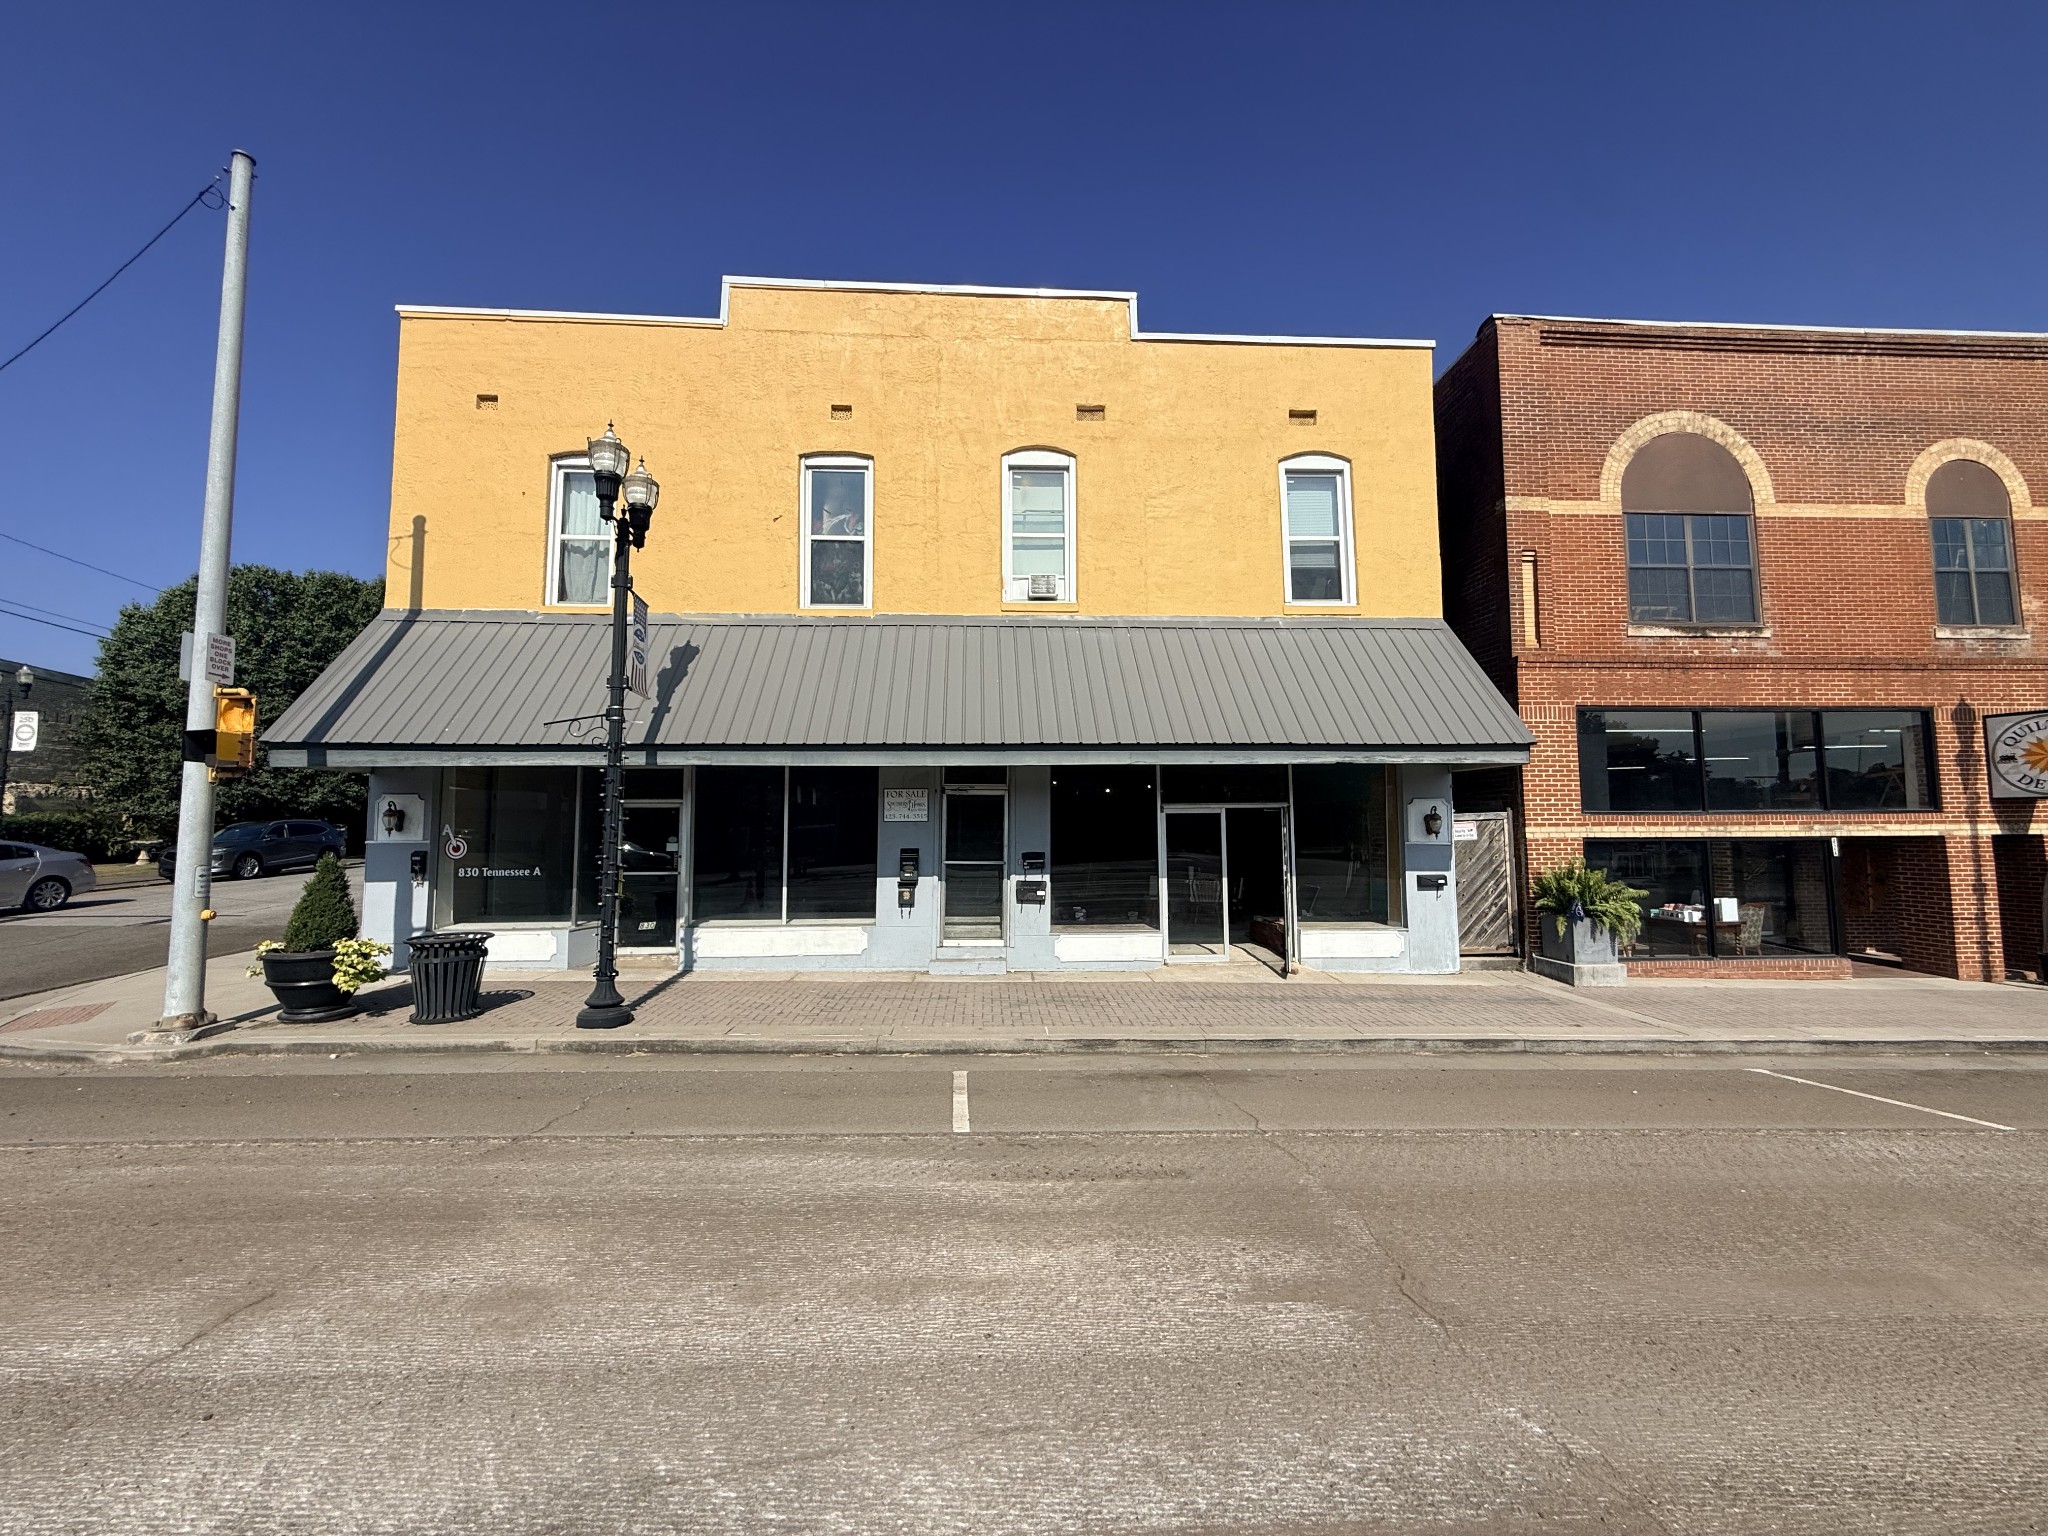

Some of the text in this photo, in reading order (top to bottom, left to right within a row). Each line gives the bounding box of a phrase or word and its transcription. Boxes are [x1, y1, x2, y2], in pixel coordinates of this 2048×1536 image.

[212, 637, 232, 647] MORE
[210, 643, 233, 654] SHOPS
[214, 651, 228, 659] ONE
[209, 656, 232, 666] BLOCK
[211, 663, 230, 672] OVER
[2003, 719, 2048, 747] QUIL
[886, 790, 926, 798] FOR SALE
[458, 866, 541, 877] 830 Tennessee A
[640, 922, 655, 930] 830
